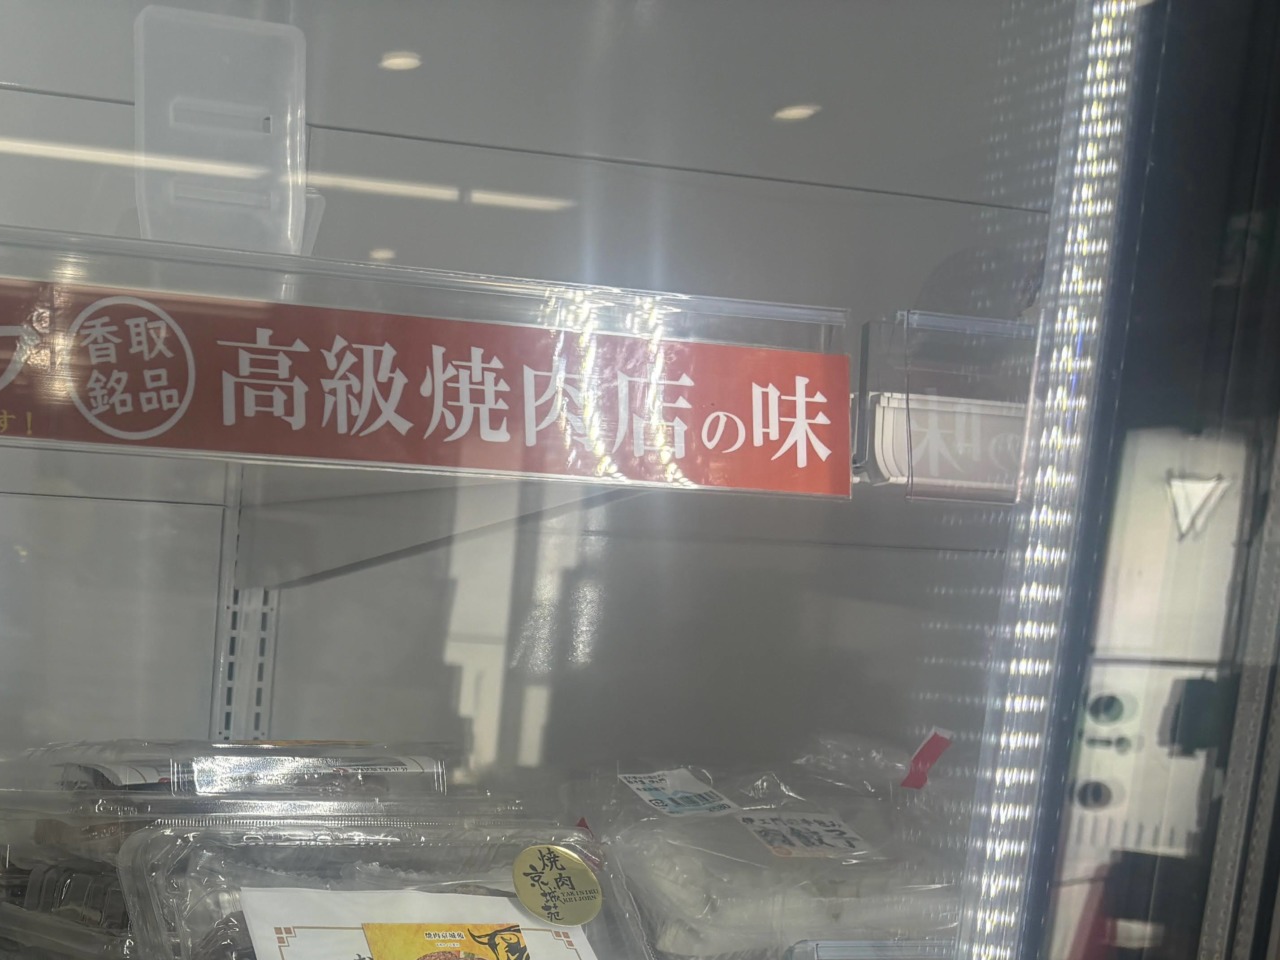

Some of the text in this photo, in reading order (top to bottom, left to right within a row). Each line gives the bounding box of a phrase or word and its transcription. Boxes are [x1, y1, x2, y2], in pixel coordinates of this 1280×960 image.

[78, 315, 175, 362] 香取
[85, 368, 180, 417] 銘品
[217, 326, 832, 470] 高級焼肉店の味
